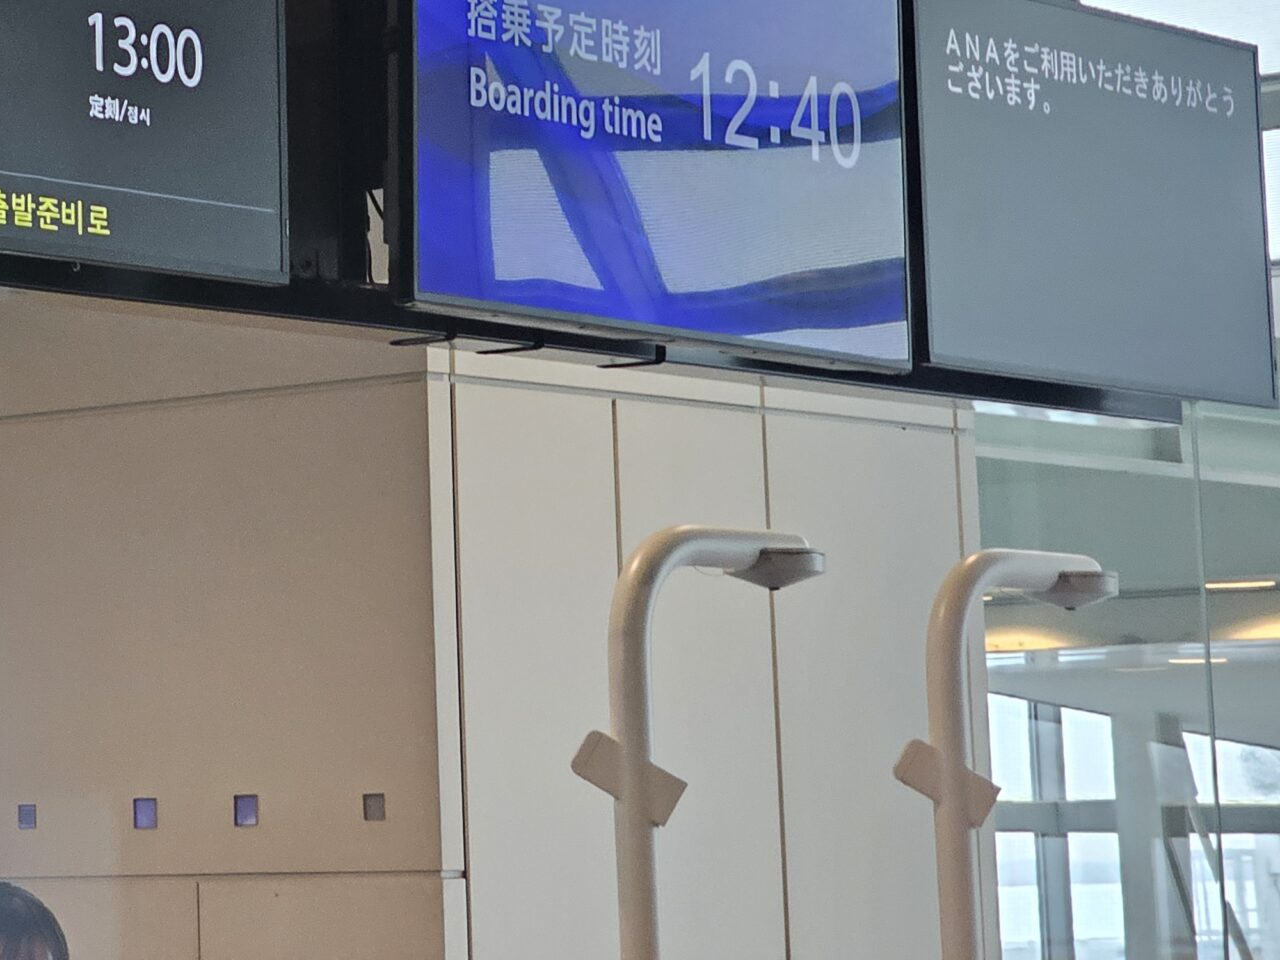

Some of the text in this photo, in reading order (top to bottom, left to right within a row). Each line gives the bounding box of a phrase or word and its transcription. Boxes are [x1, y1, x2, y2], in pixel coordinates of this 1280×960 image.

[87, 12, 203, 88] 13:00
[947, 61, 1051, 115] ございます。
[469, 66, 663, 142] Boarding time
[689, 51, 862, 170] 12:40
